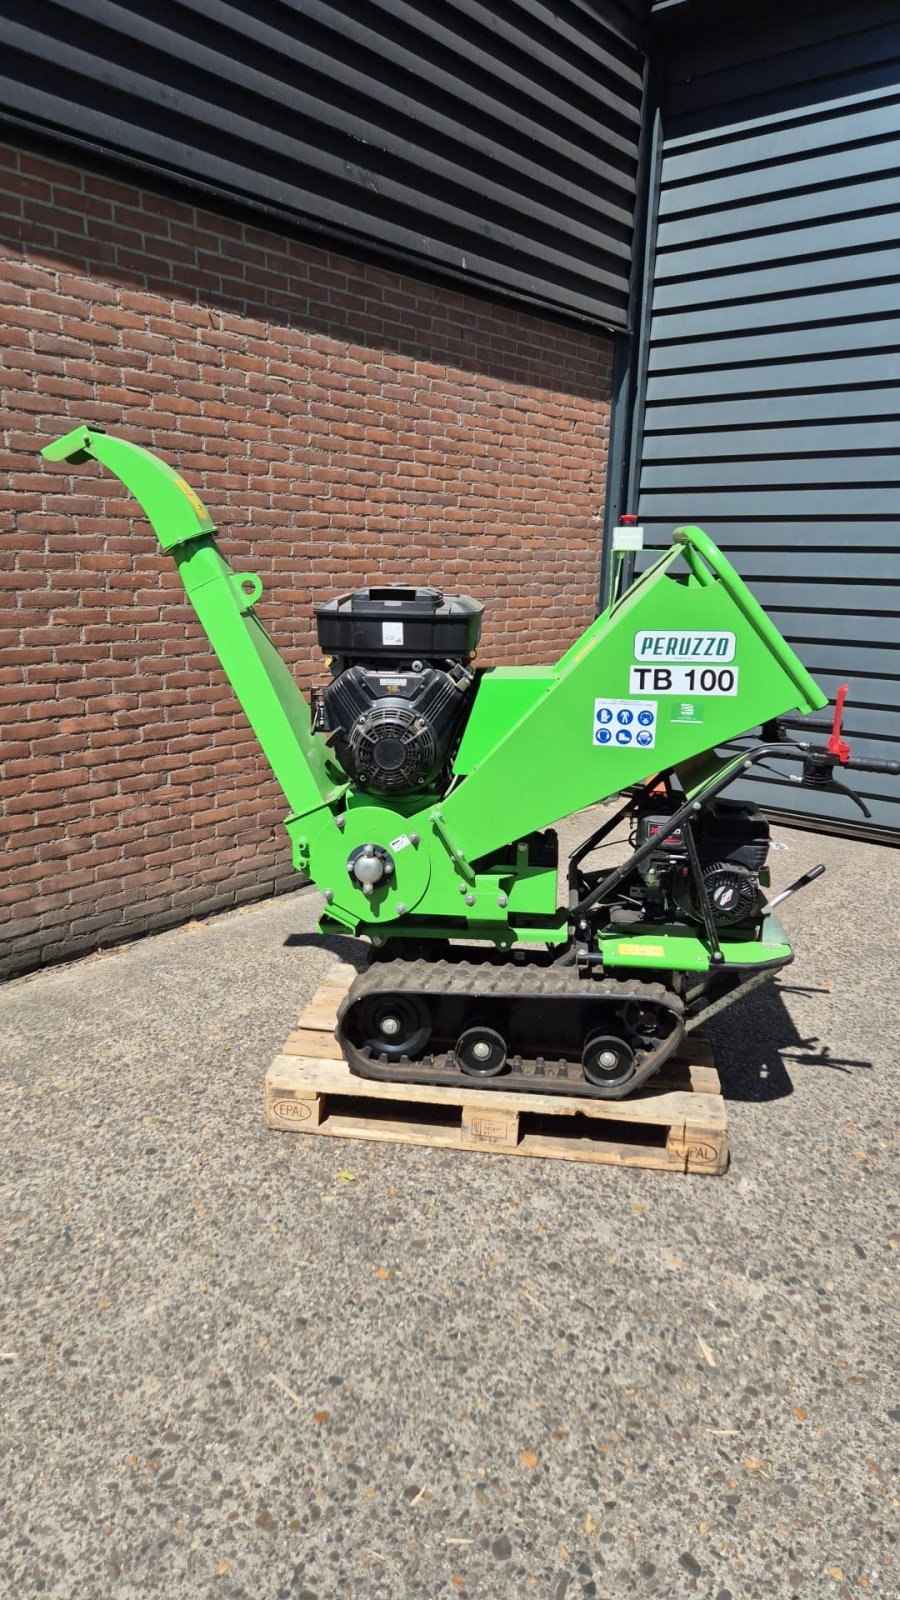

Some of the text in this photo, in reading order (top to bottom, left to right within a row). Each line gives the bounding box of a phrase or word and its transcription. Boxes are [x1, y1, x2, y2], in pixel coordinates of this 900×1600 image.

[640, 637, 729, 656] PERUZZO
[634, 668, 735, 692] TB 100
[279, 1104, 305, 1117] EPAL
